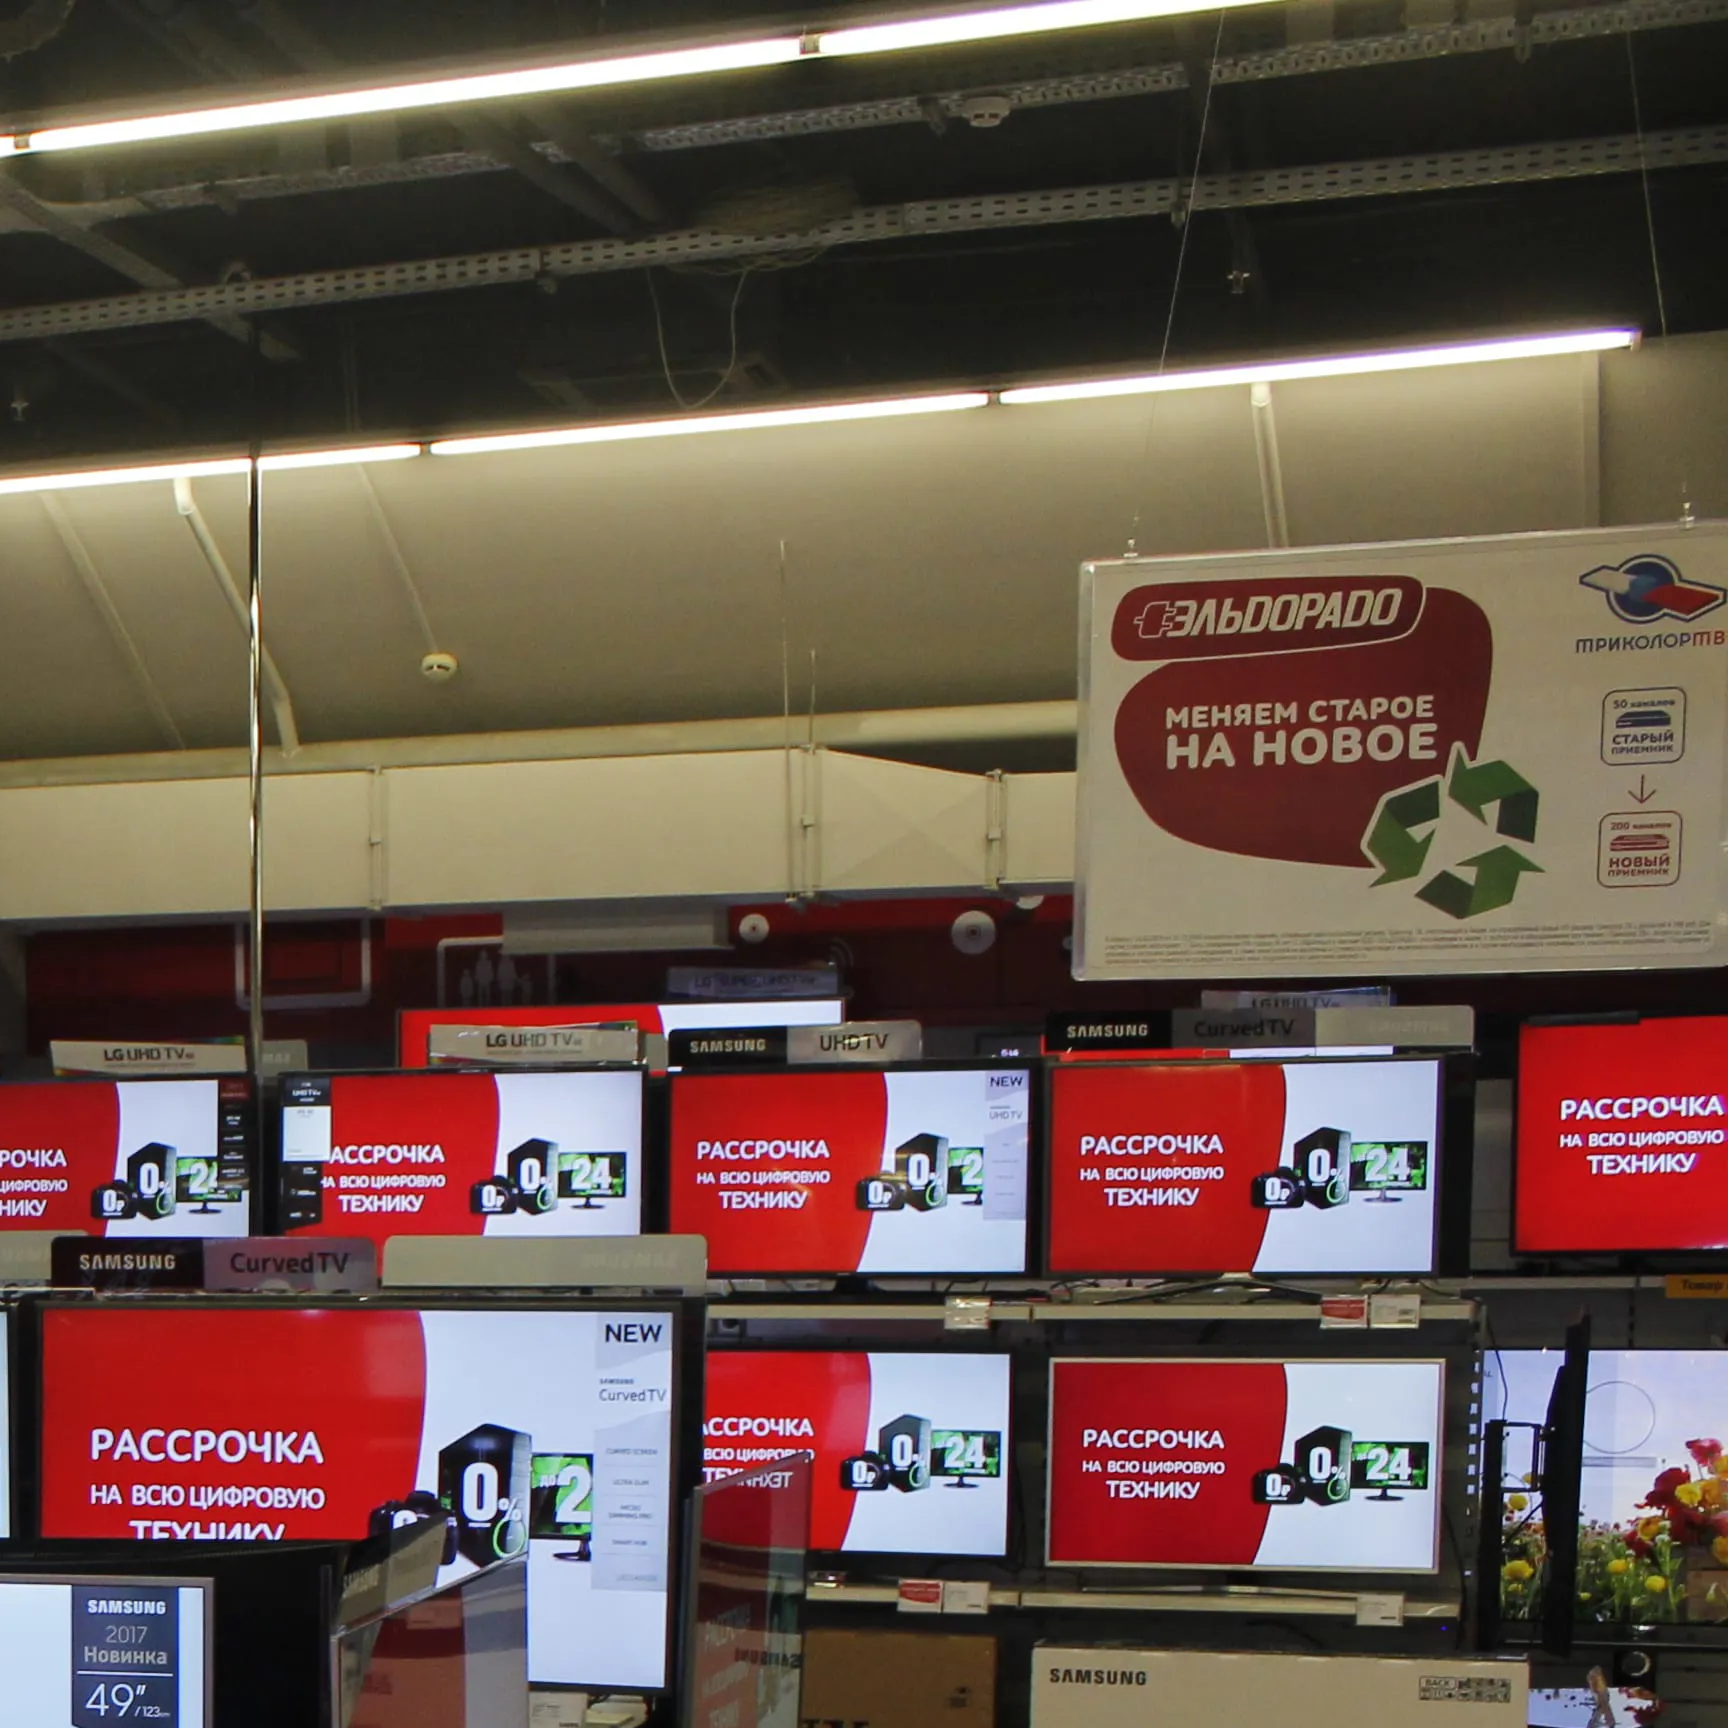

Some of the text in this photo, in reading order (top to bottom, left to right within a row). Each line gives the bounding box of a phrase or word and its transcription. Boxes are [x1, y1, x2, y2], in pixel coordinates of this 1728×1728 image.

[1165, 695, 1435, 729] МЕНЯЕМ СТАРОЕ
[1166, 722, 1438, 770] НА НОВОЕ
[1612, 729, 1674, 745] СТАРЫЙ
[1609, 854, 1671, 869] НОВЫЙ
[1067, 1023, 1149, 1040] SAMSUNG
[104, 1048, 124, 1062] LG
[690, 1038, 766, 1054] SAMSUNG
[990, 1075, 1023, 1088] NEW
[1560, 1096, 1724, 1121] РАССРОЧКА
[696, 1140, 831, 1161] РАССРОЧКА
[1080, 1135, 1224, 1157] РАССРОЧКА
[1586, 1153, 1697, 1176] ТЕХНИКУ
[339, 1194, 424, 1213] ТЕХНИКУ
[719, 1191, 808, 1209] ТЕХНИКУ
[1104, 1187, 1200, 1207] ТЕХНИКУ
[79, 1253, 176, 1273] SAMSUNG
[605, 1324, 663, 1343] NEW
[90, 1427, 325, 1465] РАССРОЧКА
[1082, 1427, 1225, 1450] РАССРОЧКА
[1105, 1480, 1201, 1500] ТЕХНИКУ
[87, 1599, 167, 1616] SAMSUNG
[105, 1625, 147, 1645] 2017
[83, 1646, 168, 1666] Новинка
[1049, 1667, 1148, 1687] SAMSUNG
